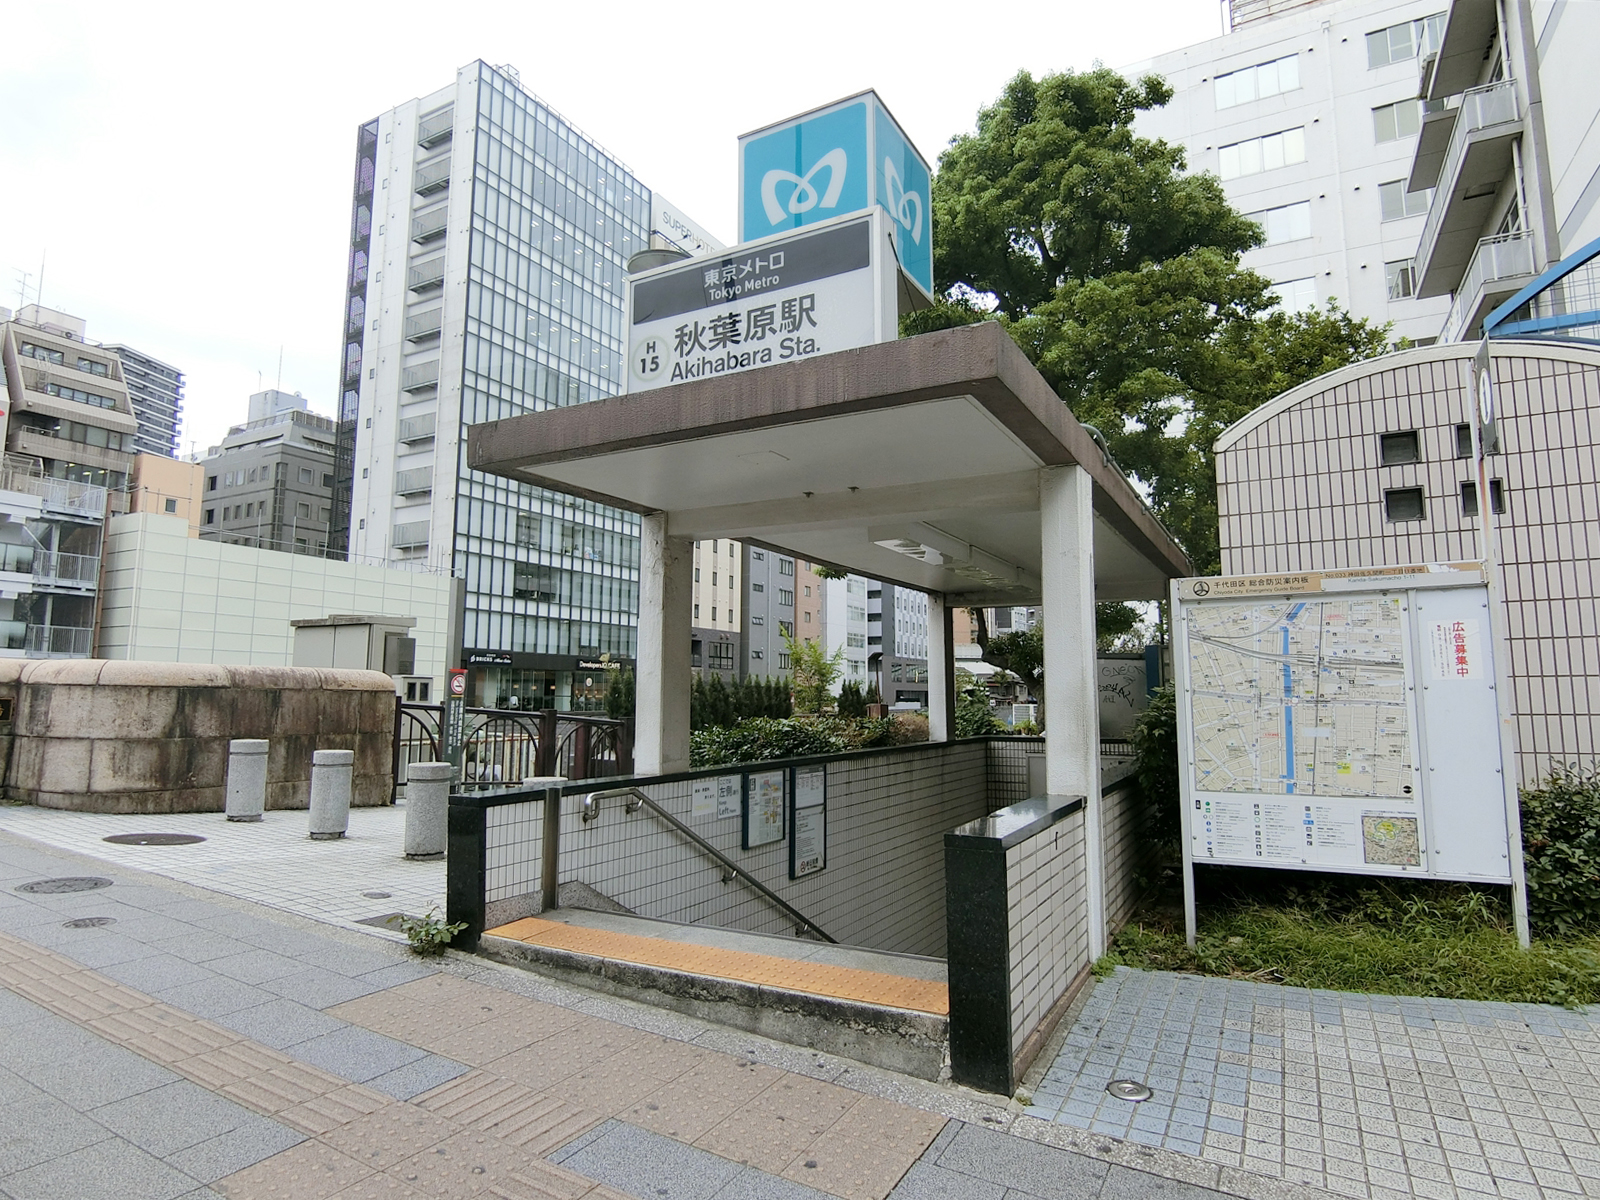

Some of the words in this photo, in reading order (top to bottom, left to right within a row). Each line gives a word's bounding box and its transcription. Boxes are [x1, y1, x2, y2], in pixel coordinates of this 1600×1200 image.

[704, 251, 785, 289] 東京メトロ
[709, 283, 742, 300] Tokyo
[745, 274, 780, 293] Metro
[673, 293, 818, 359] 秋葉原駅
[645, 341, 656, 354] H
[640, 356, 660, 374] 15
[670, 346, 772, 382] Akihabara
[779, 336, 821, 360] Sta.
[1213, 580, 1247, 588] 千代田区
[1249, 576, 1310, 587] 総合防災案内板
[1213, 588, 1233, 596] Chiyoda
[1452, 621, 1469, 677] 広告募集中
[718, 806, 730, 816] Left
